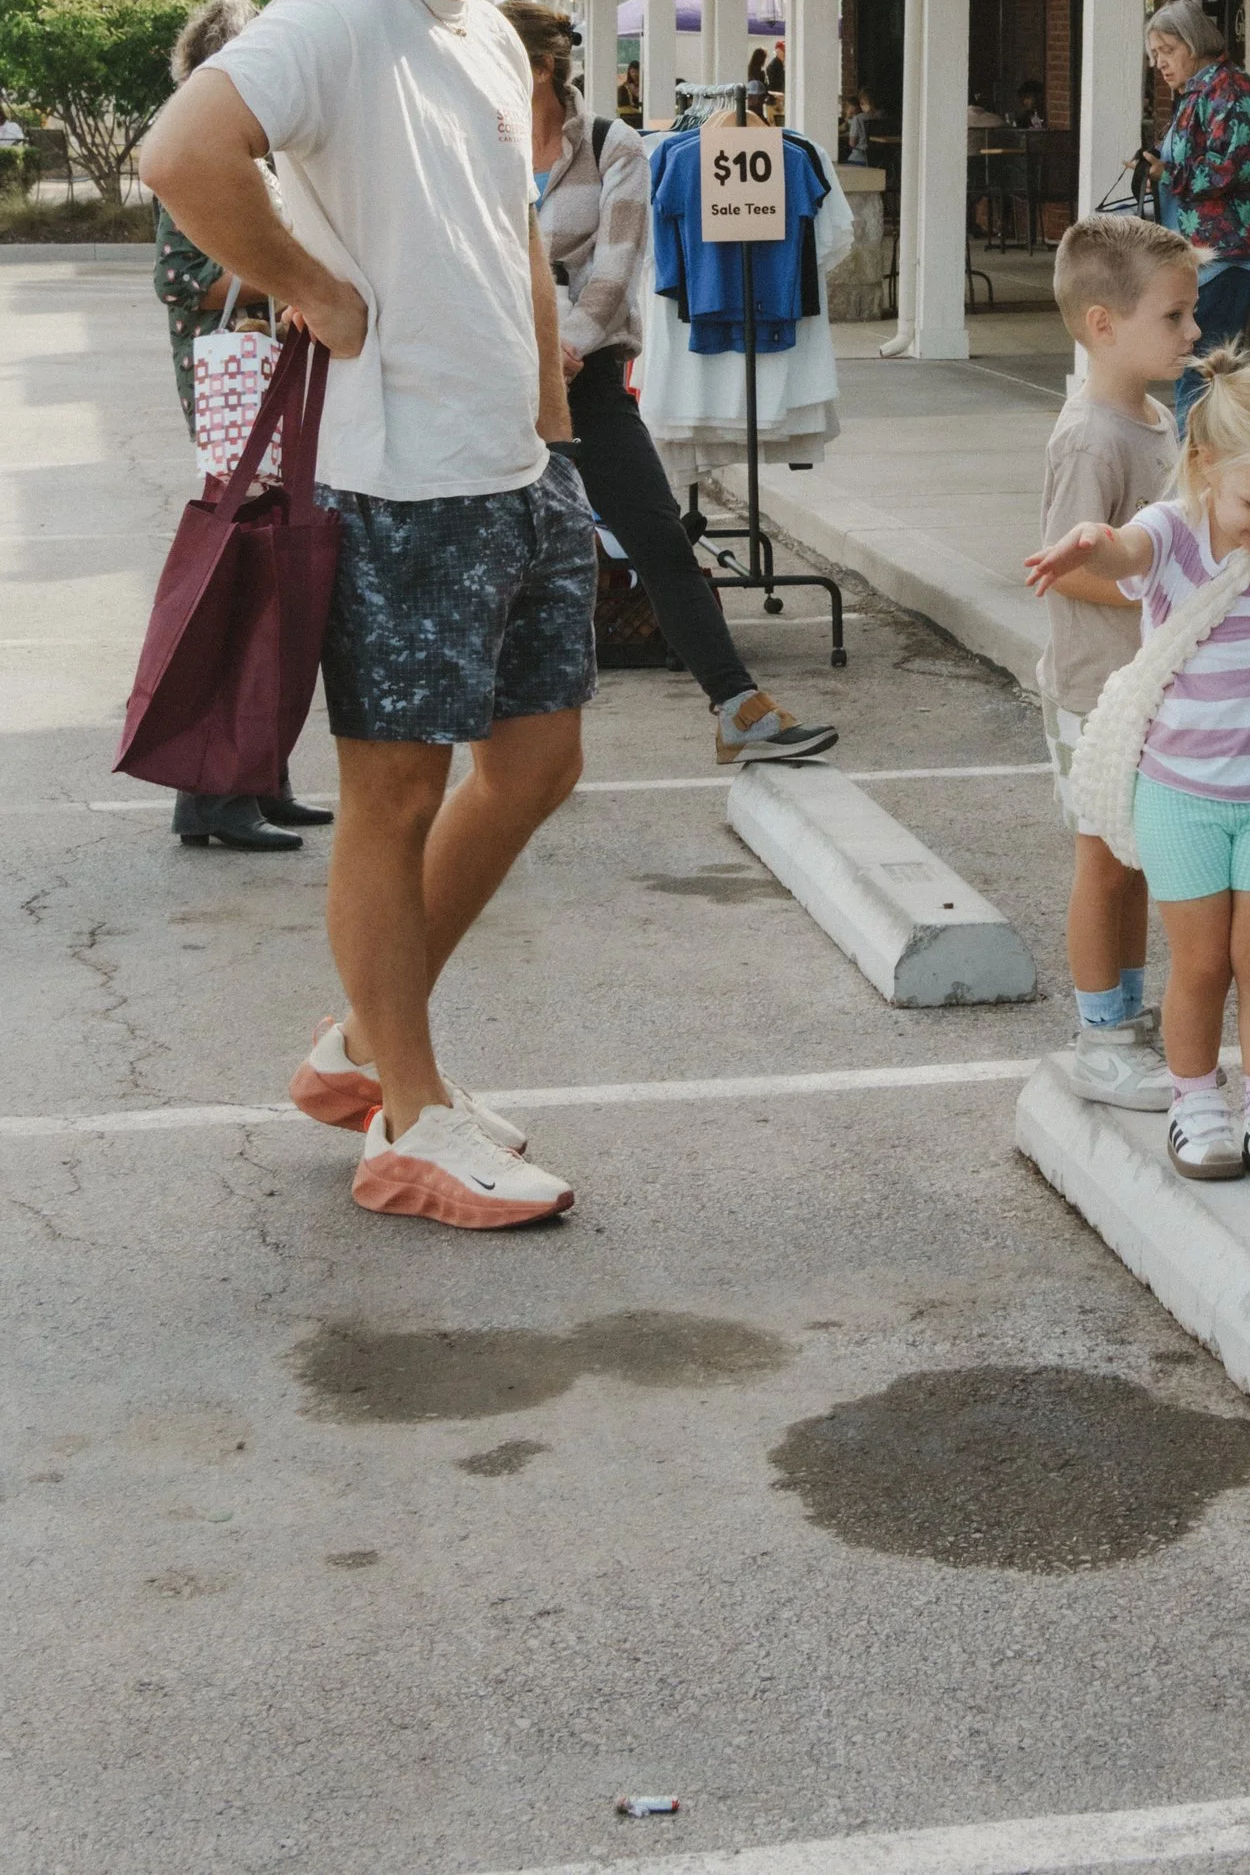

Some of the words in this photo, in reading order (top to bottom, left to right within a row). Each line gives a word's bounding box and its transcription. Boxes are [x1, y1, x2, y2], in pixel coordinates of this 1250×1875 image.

[713, 150, 772, 186] $10
[711, 204, 740, 216] Sale
[745, 203, 776, 215] Tees
